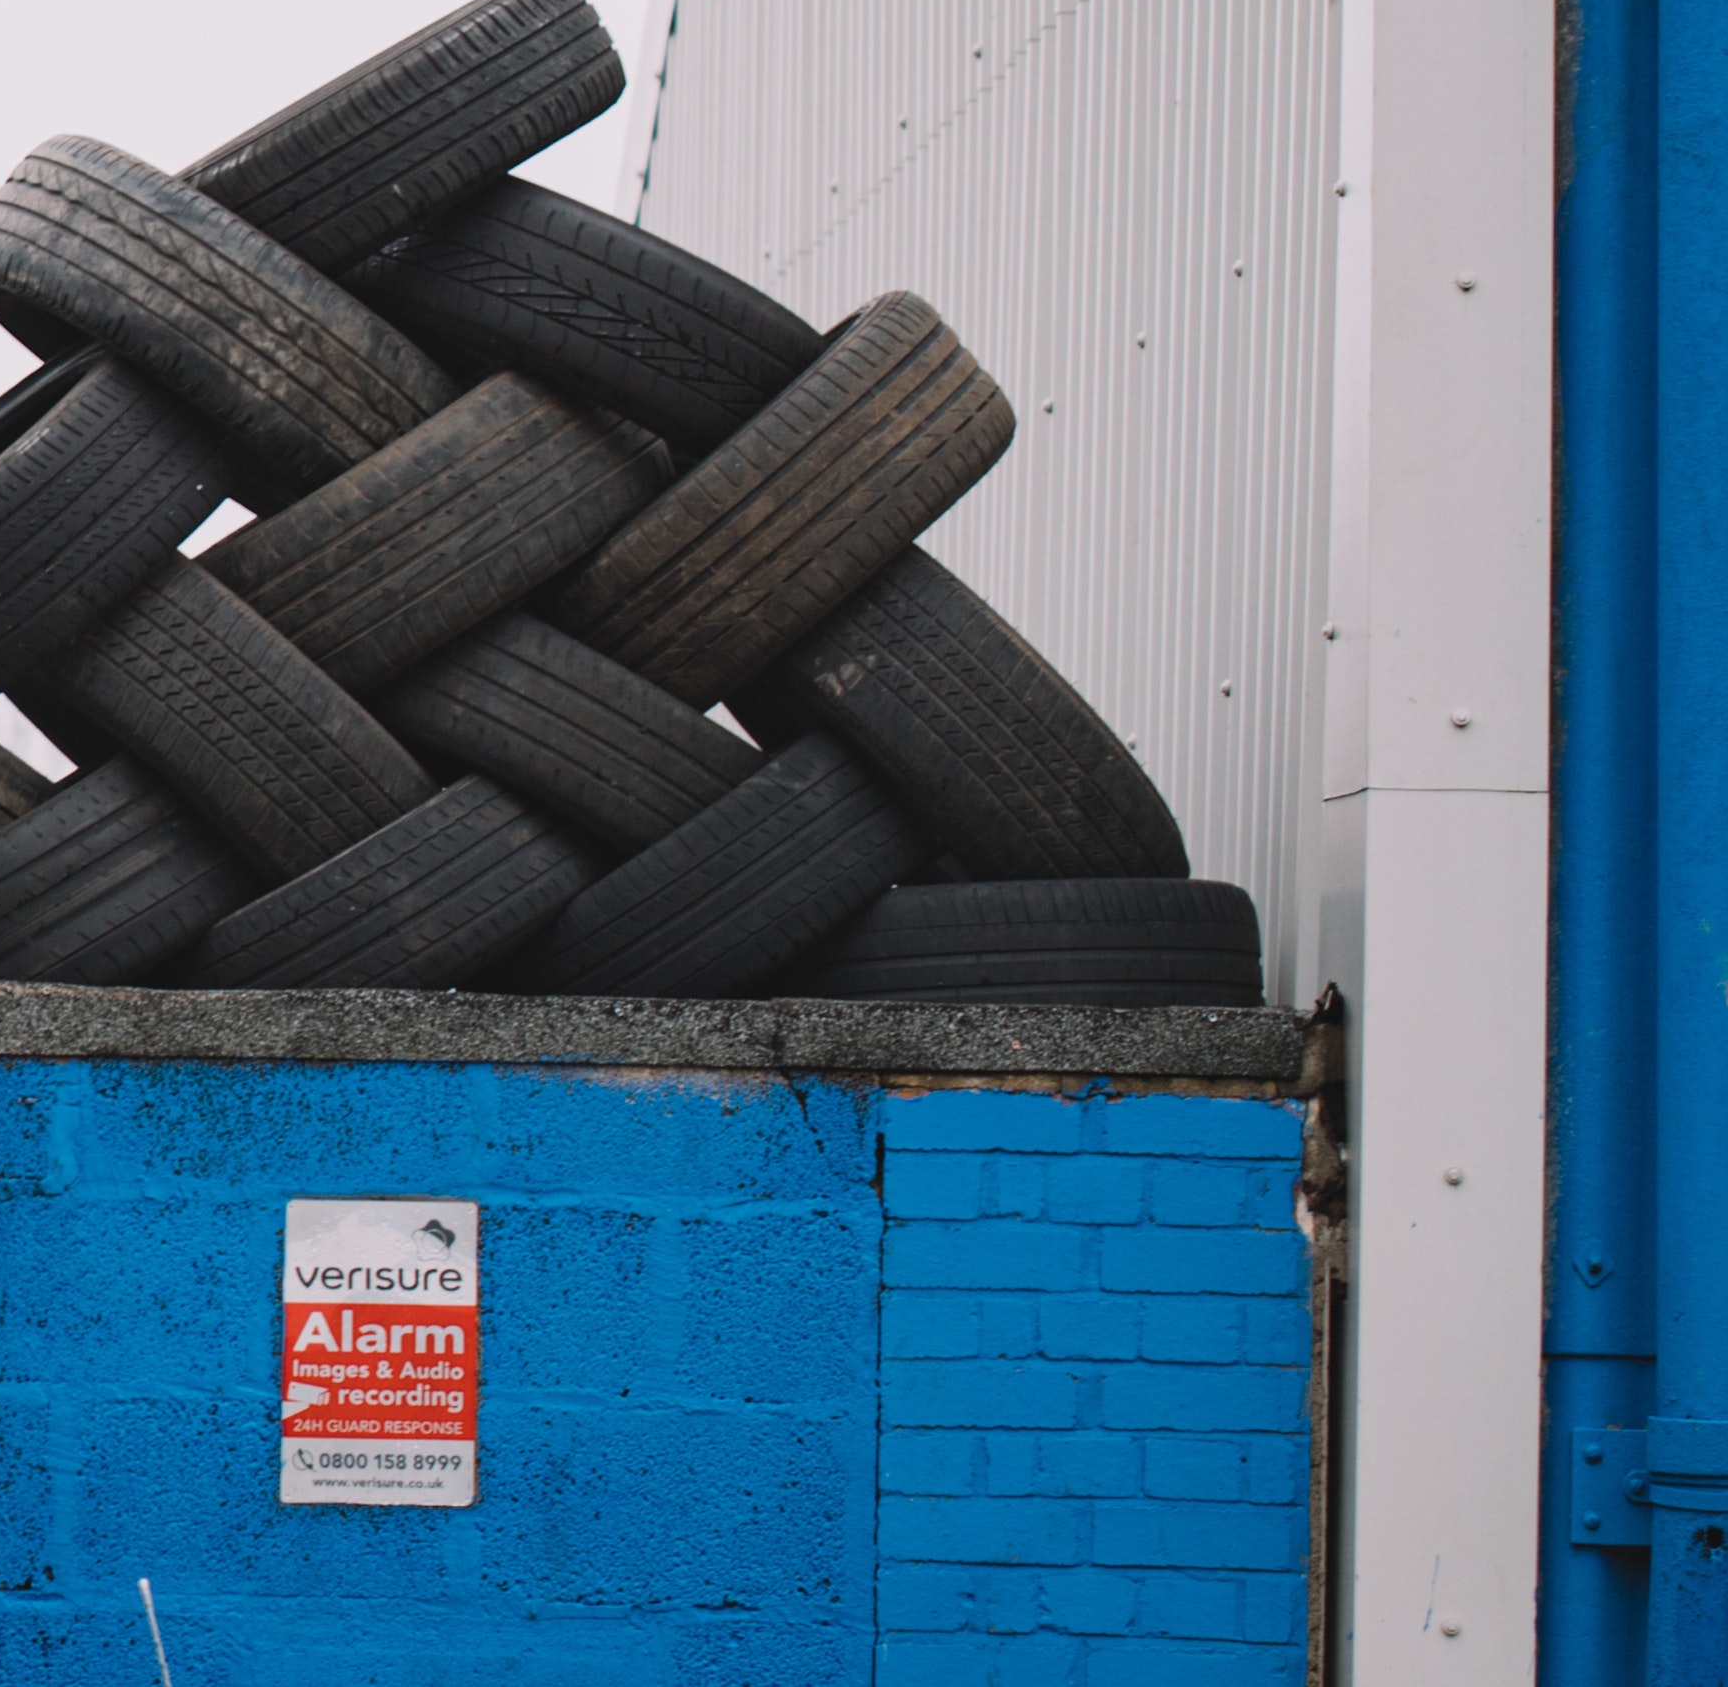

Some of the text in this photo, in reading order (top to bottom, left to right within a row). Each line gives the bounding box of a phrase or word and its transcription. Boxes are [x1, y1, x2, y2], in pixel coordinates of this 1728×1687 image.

[296, 1267, 462, 1291] verisure
[294, 1310, 464, 1354] Alarm
[293, 1361, 463, 1382] Images & Audio
[338, 1383, 464, 1413] recording
[293, 1419, 463, 1435] 24H GUARD RESPONSE
[319, 1453, 461, 1471] 0800 158 8999
[313, 1478, 443, 1489] www.verisure.co.uk
